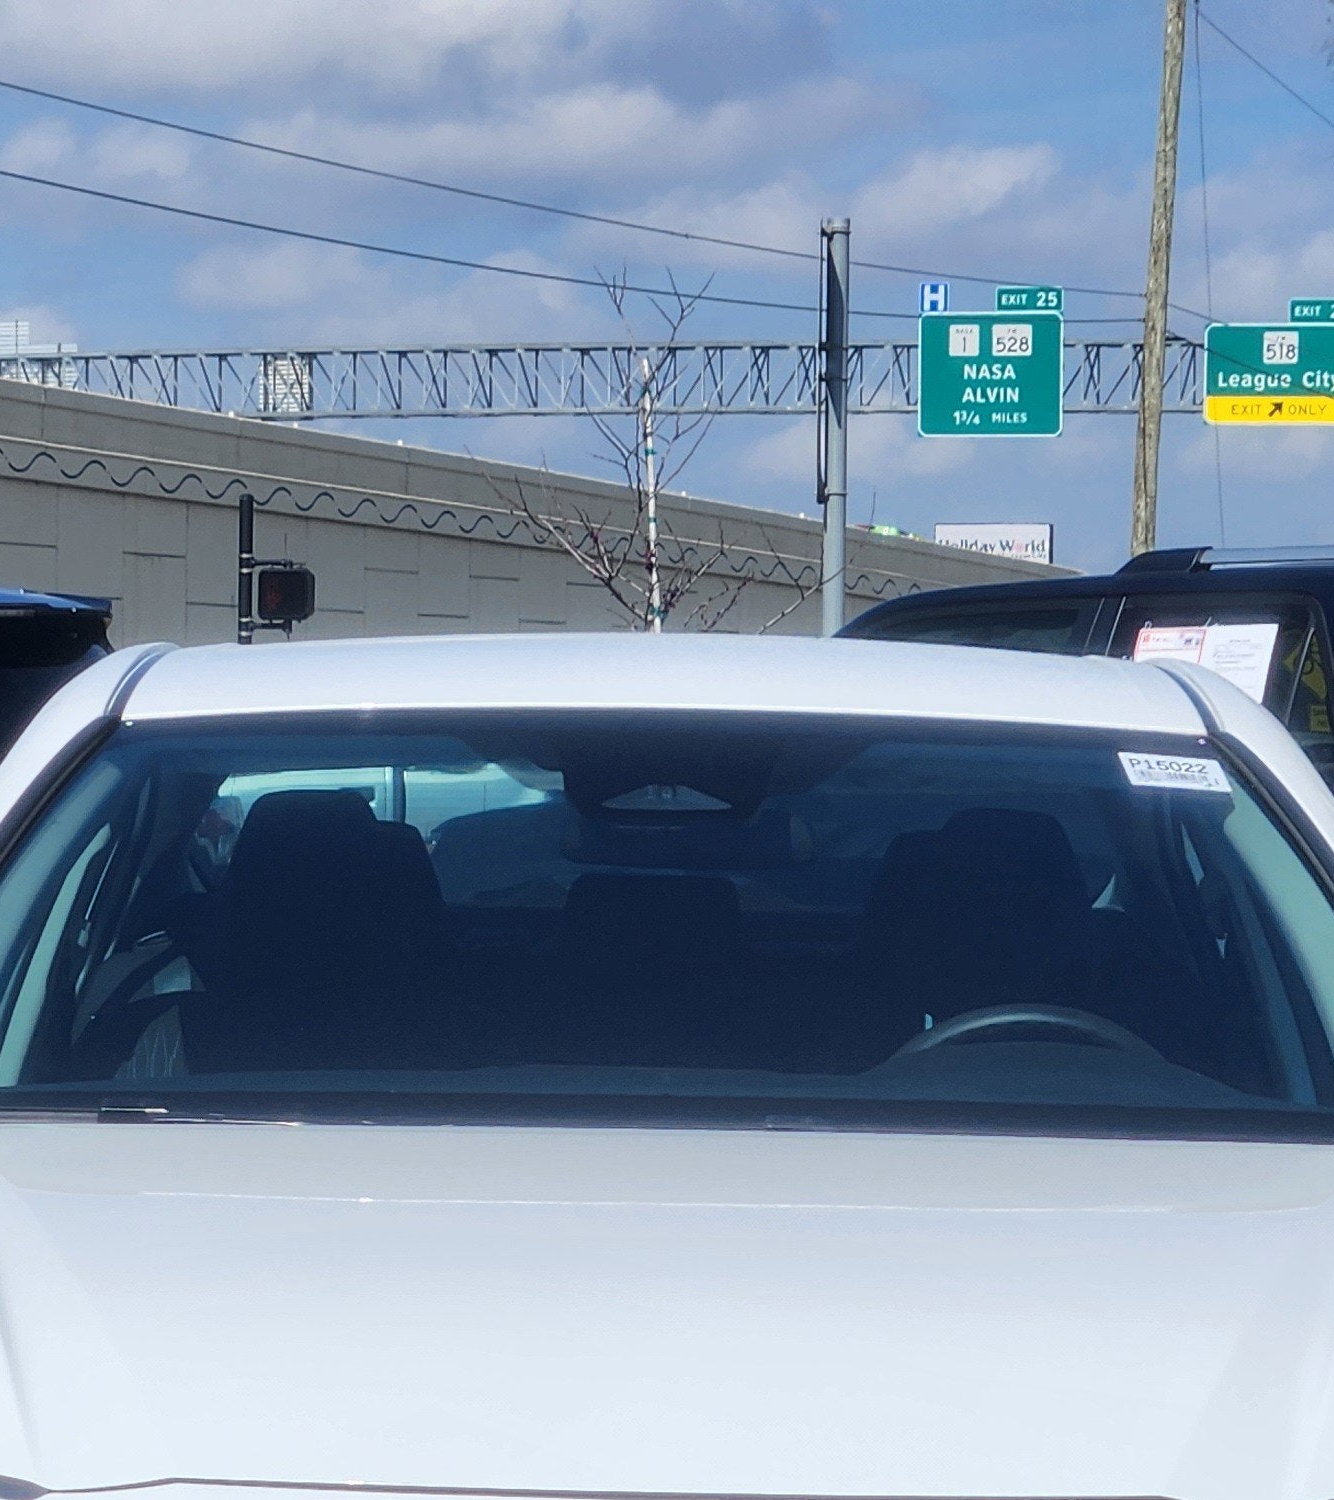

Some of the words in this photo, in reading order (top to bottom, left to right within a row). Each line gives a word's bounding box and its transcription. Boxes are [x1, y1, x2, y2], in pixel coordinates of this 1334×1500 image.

[1000, 293, 1028, 306] EXIT
[1036, 291, 1058, 307] 25
[1294, 305, 1322, 317] EXIT
[996, 336, 1030, 353] 528
[1266, 342, 1296, 361] 518
[963, 363, 1017, 380] NASA
[1218, 371, 1292, 392] League
[962, 386, 1020, 404] ALVIN
[991, 412, 1028, 424] MILES
[1231, 404, 1262, 416] EXIT
[1288, 404, 1328, 416] ONLY
[1128, 757, 1209, 775] P15022
